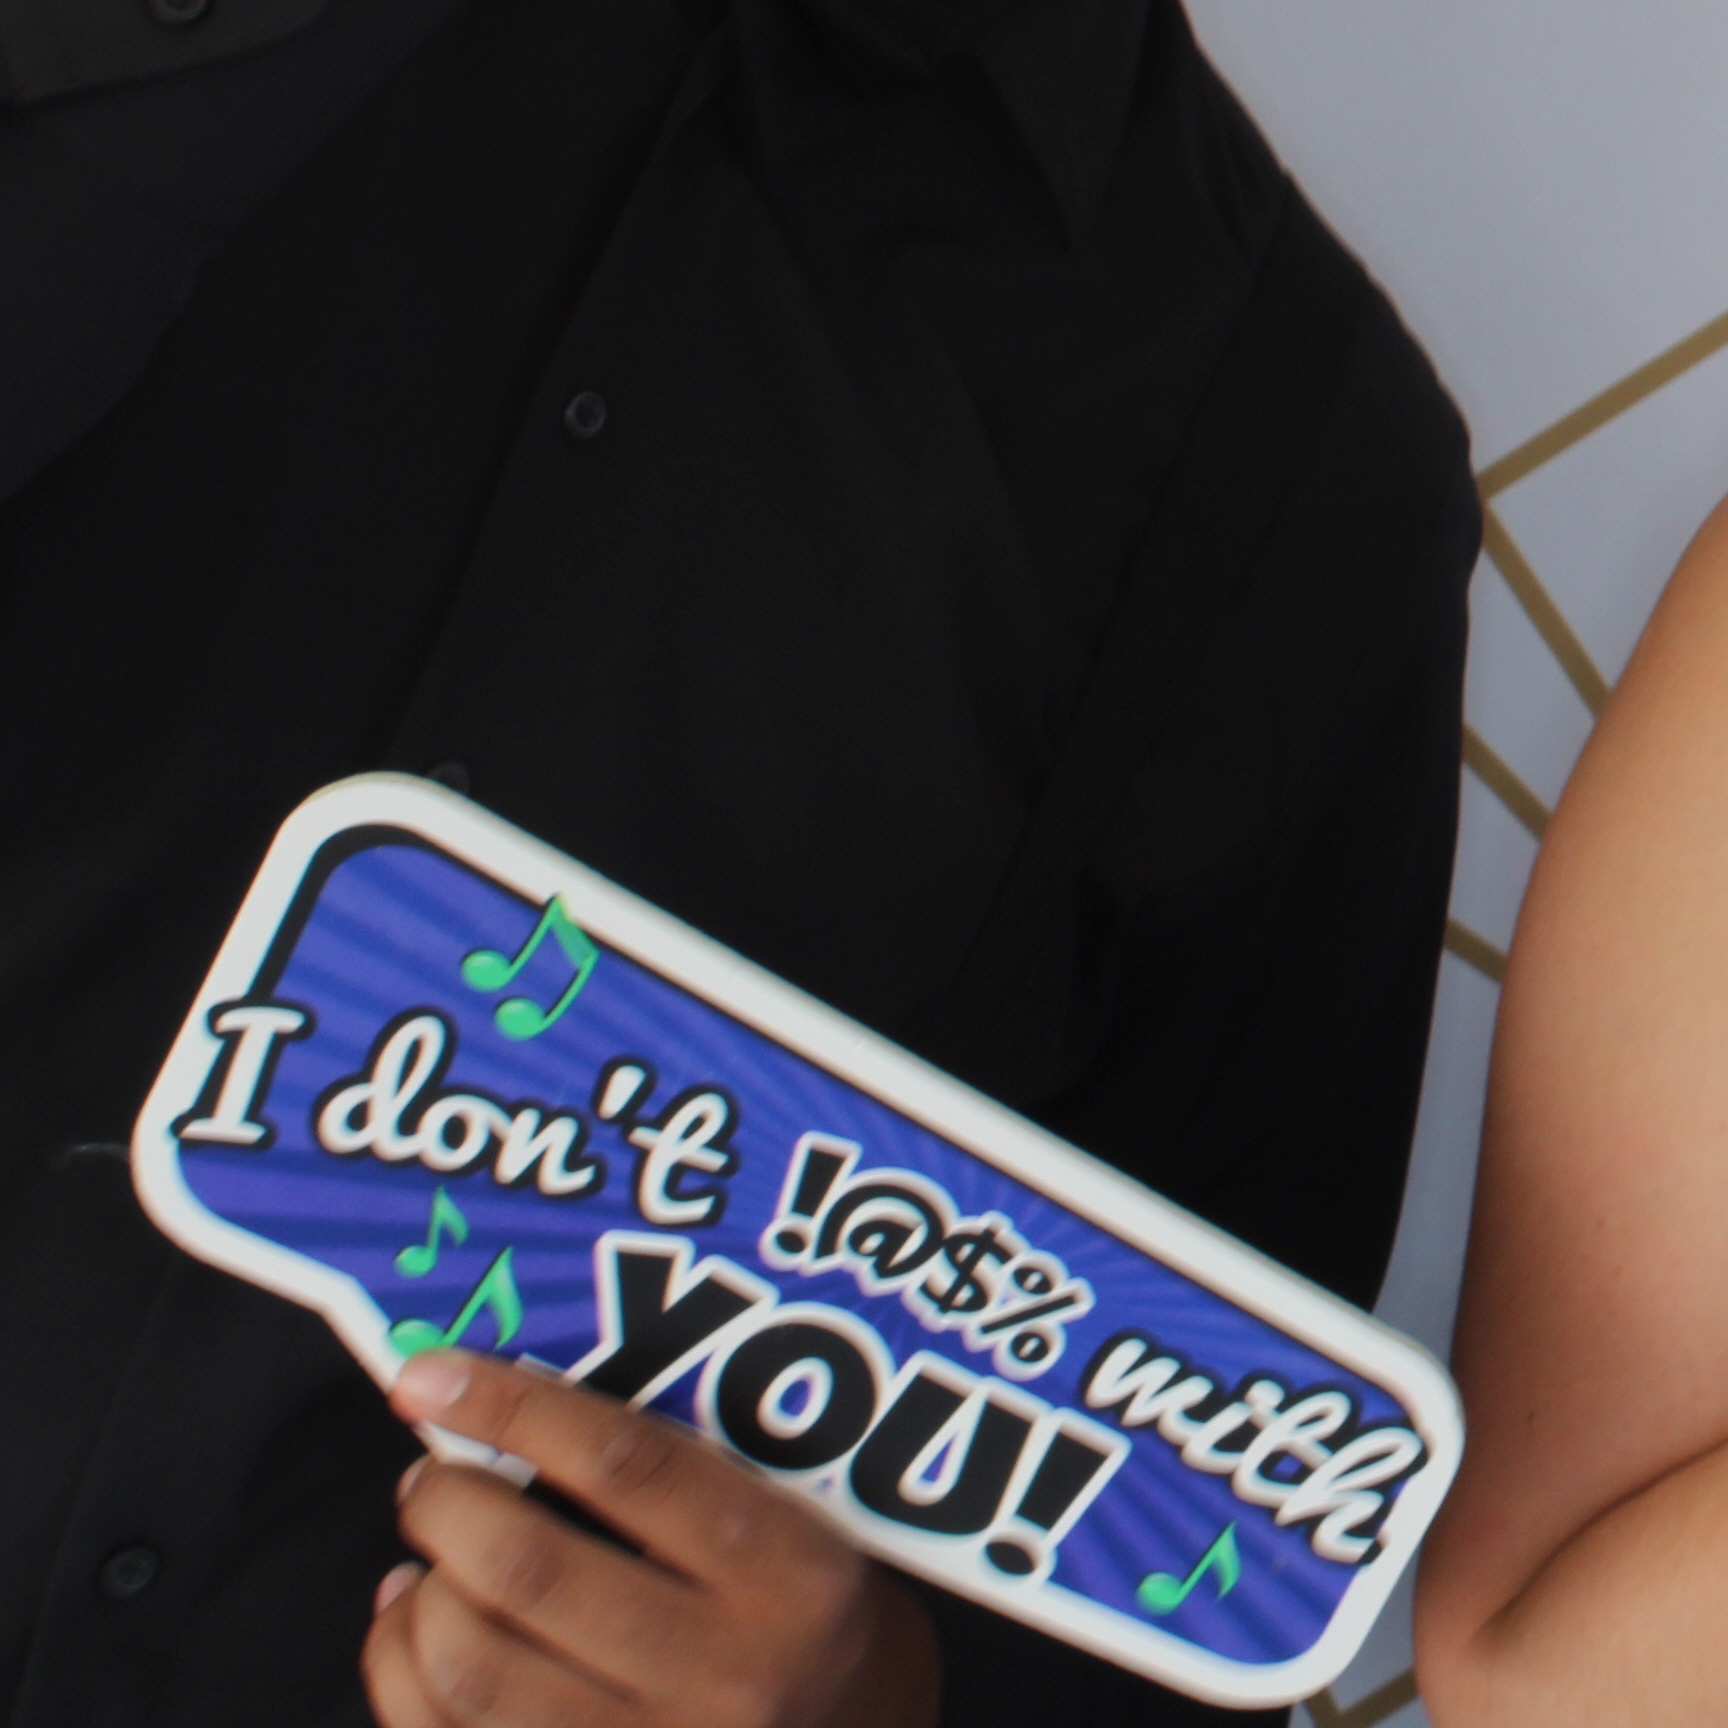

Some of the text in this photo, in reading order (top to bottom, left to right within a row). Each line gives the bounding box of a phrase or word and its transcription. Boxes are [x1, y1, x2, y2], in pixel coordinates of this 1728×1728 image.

[176, 1003, 1426, 1564] I don't !@$% with
[570, 1242, 1122, 1579] YOU!
